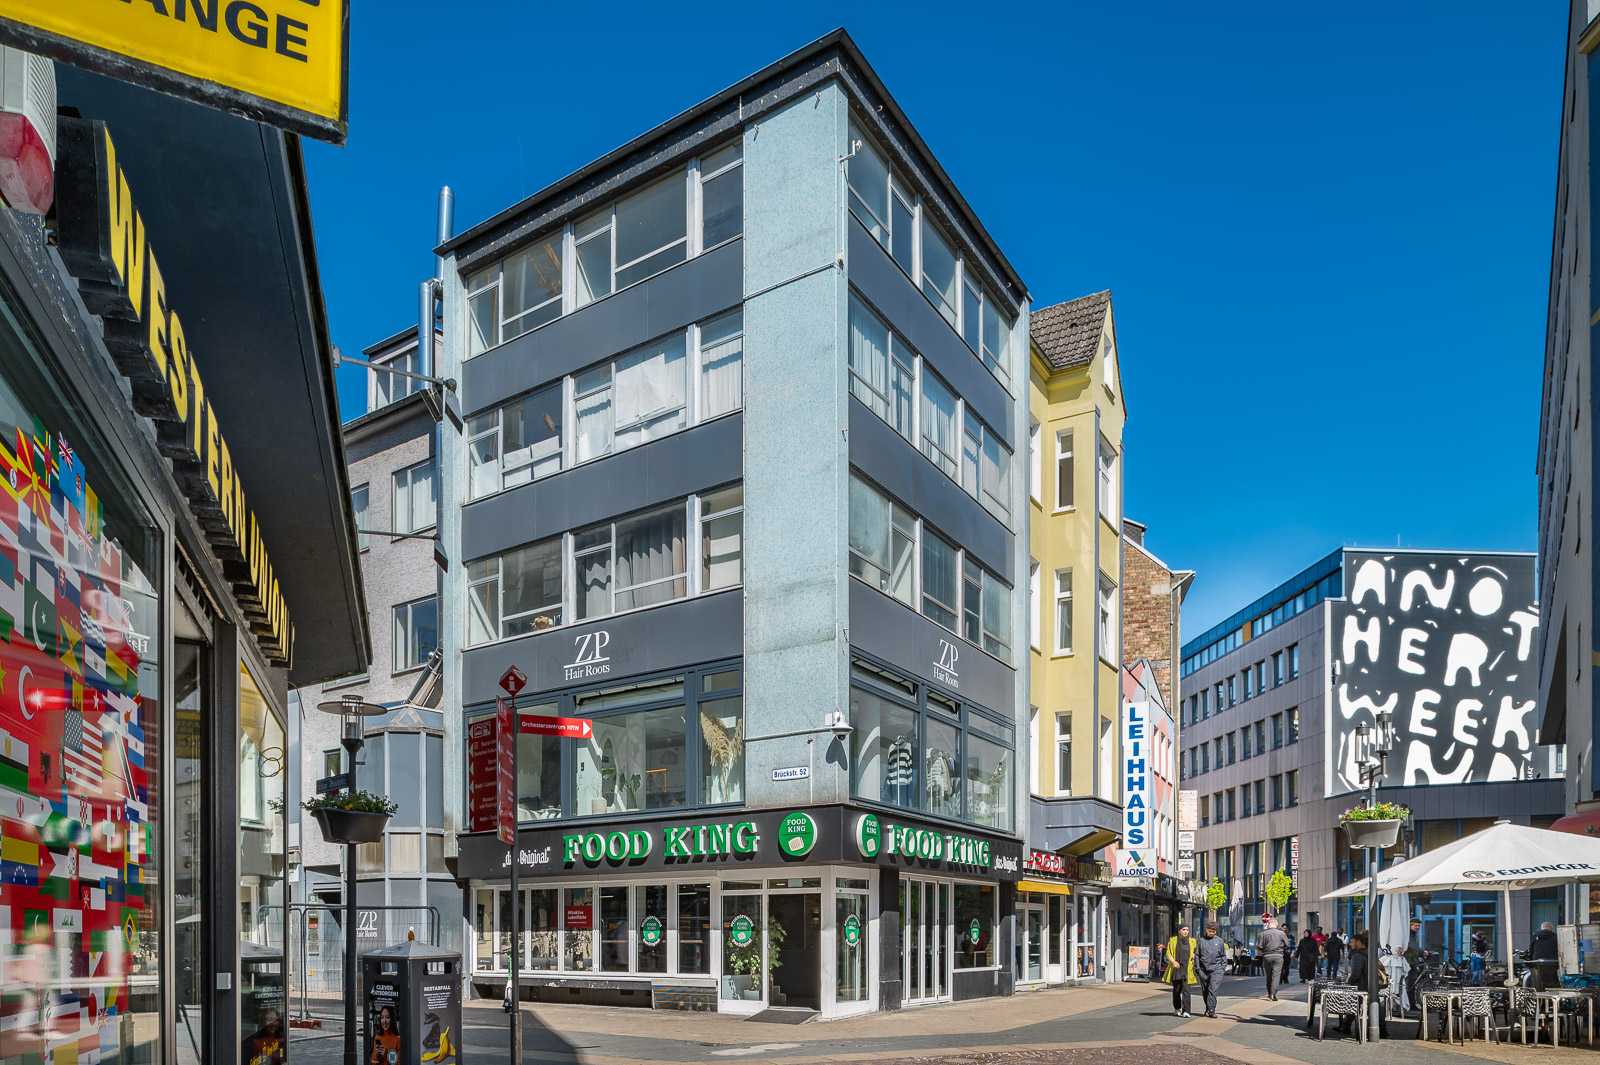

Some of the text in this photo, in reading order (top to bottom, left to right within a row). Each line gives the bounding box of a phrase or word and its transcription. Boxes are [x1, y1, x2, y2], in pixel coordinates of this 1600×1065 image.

[104, 124, 290, 662] WESTERN UNION
[574, 630, 610, 664] ZP
[939, 638, 959, 671] ZP
[564, 664, 610, 681] Hair Roots
[933, 667, 959, 689] Hair Roots
[521, 721, 566, 730] Orchesterzentrum
[773, 768, 807, 778] Brückstr. 52
[1127, 706, 1145, 845] LEIHHAUS
[786, 818, 807, 826] FOOD
[787, 825, 806, 833] KING
[865, 819, 878, 828] FOOD
[866, 826, 877, 835] KING
[562, 821, 761, 863] FOOD KING
[888, 824, 991, 867] FOOD KING
[1118, 868, 1155, 876] ALONSO
[1496, 863, 1596, 876] ERDINGER
[359, 911, 378, 929] ZP
[364, 930, 378, 938] Roots
